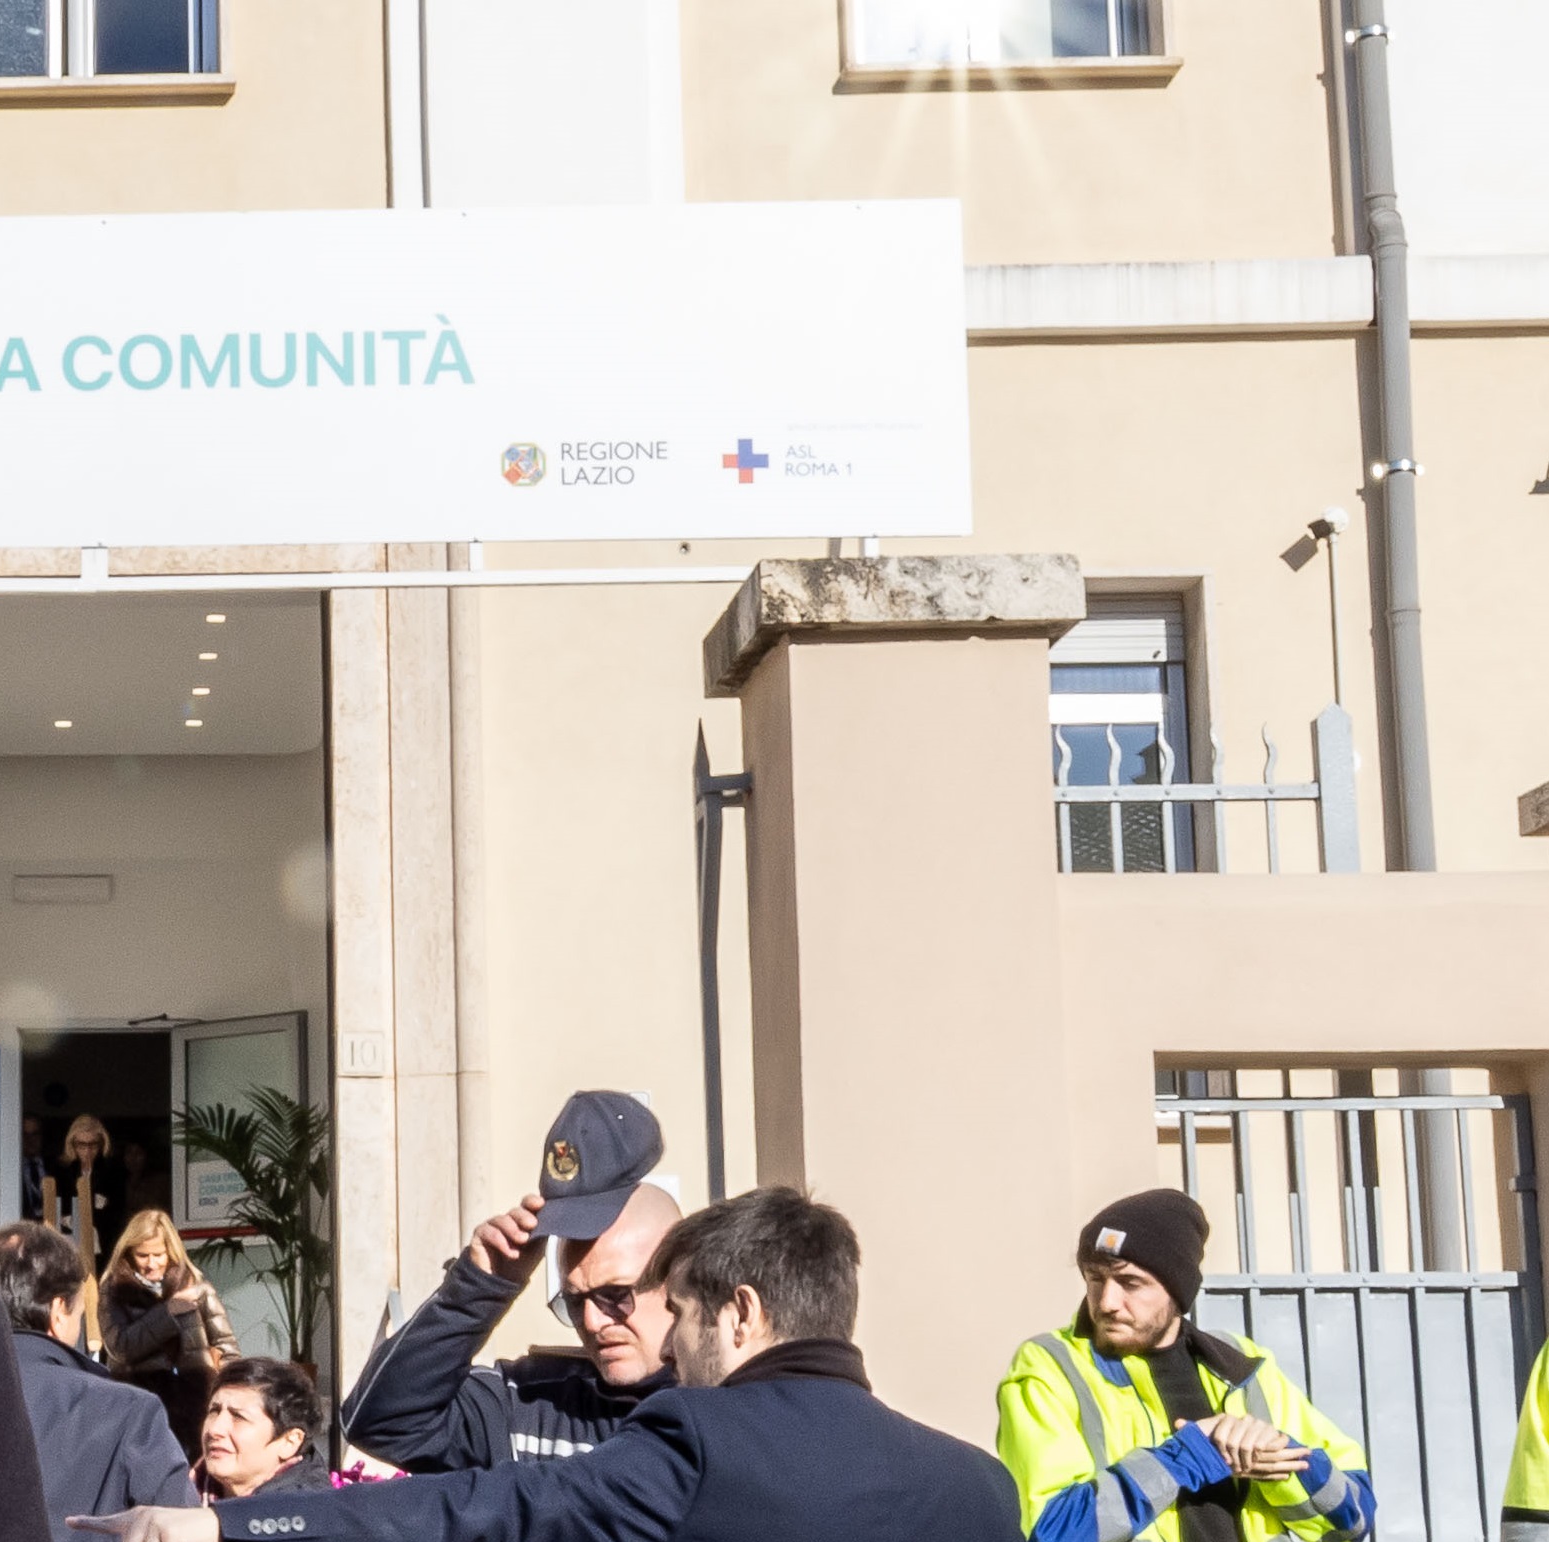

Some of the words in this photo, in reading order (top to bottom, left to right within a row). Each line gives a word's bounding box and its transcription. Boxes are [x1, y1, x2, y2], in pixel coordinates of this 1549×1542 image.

[61, 314, 475, 392] COMUNITÀ
[560, 440, 668, 461] REGIONE
[785, 444, 817, 459] ASL
[560, 465, 636, 486] LAZIO
[784, 462, 840, 477] ROMA
[845, 461, 853, 476] 1
